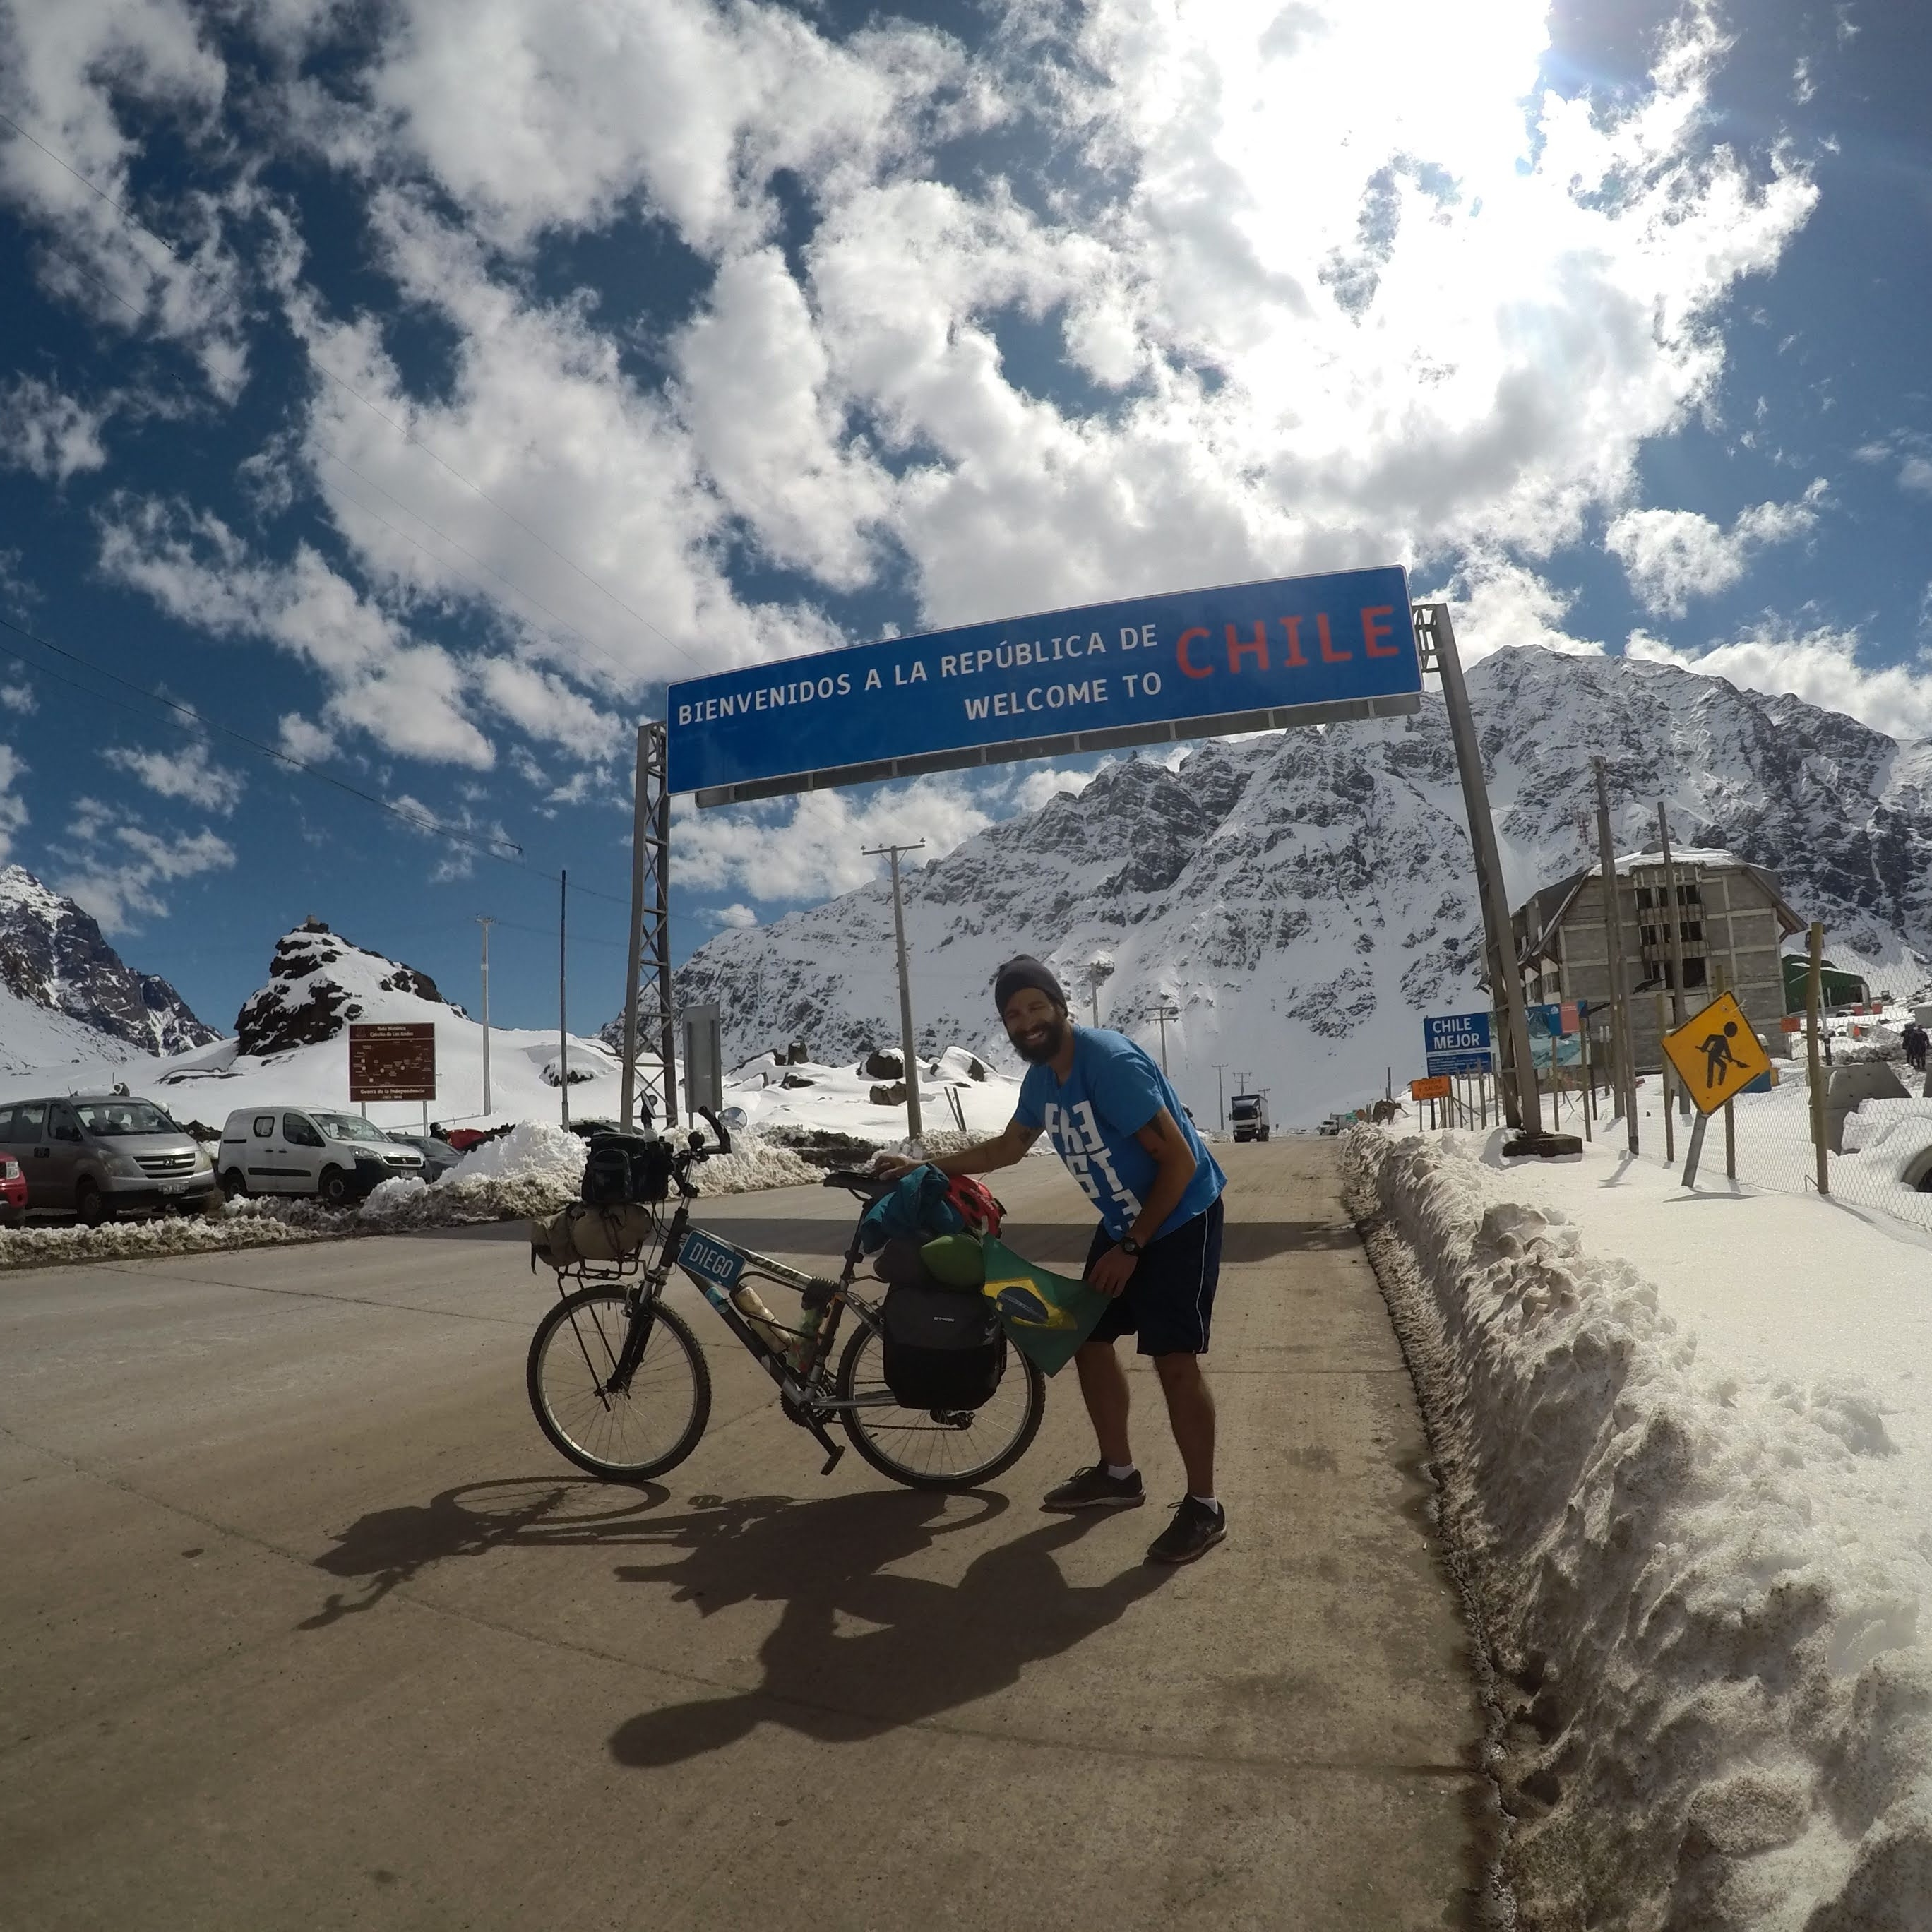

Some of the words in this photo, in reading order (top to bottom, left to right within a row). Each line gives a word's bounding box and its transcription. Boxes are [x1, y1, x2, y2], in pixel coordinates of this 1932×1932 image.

[679, 673, 851, 726] BIENVENIDOS
[865, 669, 882, 691] A
[895, 661, 927, 685] LA
[941, 632, 1107, 677] REPÚBLICA
[1120, 624, 1158, 651] DE
[1176, 605, 1400, 679] CHILE
[965, 679, 1109, 720] WELCOME
[1123, 672, 1162, 698] TO
[1432, 1018, 1472, 1034] CHILE
[1433, 1033, 1480, 1049] MEJOR
[688, 1241, 734, 1279] DIEGO
